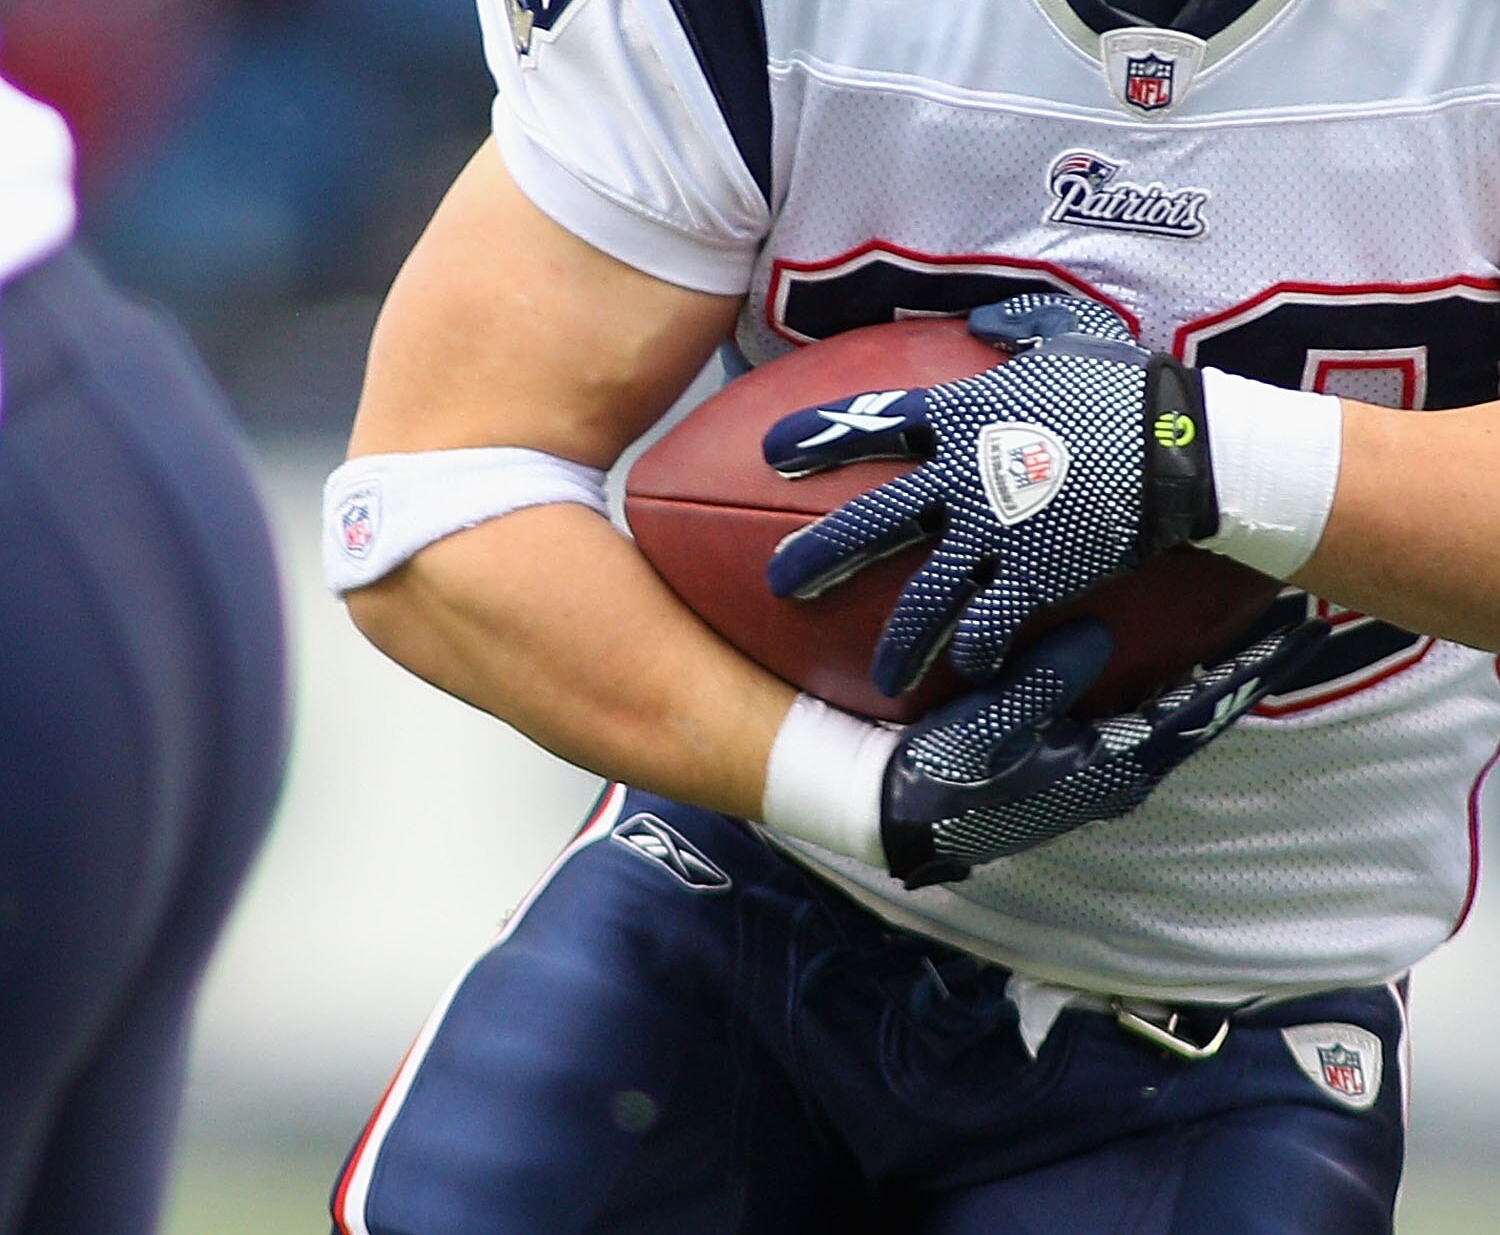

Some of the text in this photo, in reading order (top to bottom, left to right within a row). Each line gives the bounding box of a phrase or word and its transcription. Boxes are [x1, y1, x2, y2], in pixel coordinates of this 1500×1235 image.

[1128, 77, 1169, 106] NFL
[1049, 173, 1207, 237] Patriots
[1022, 442, 1051, 482] NFL
[1327, 1066, 1362, 1093] NFL
